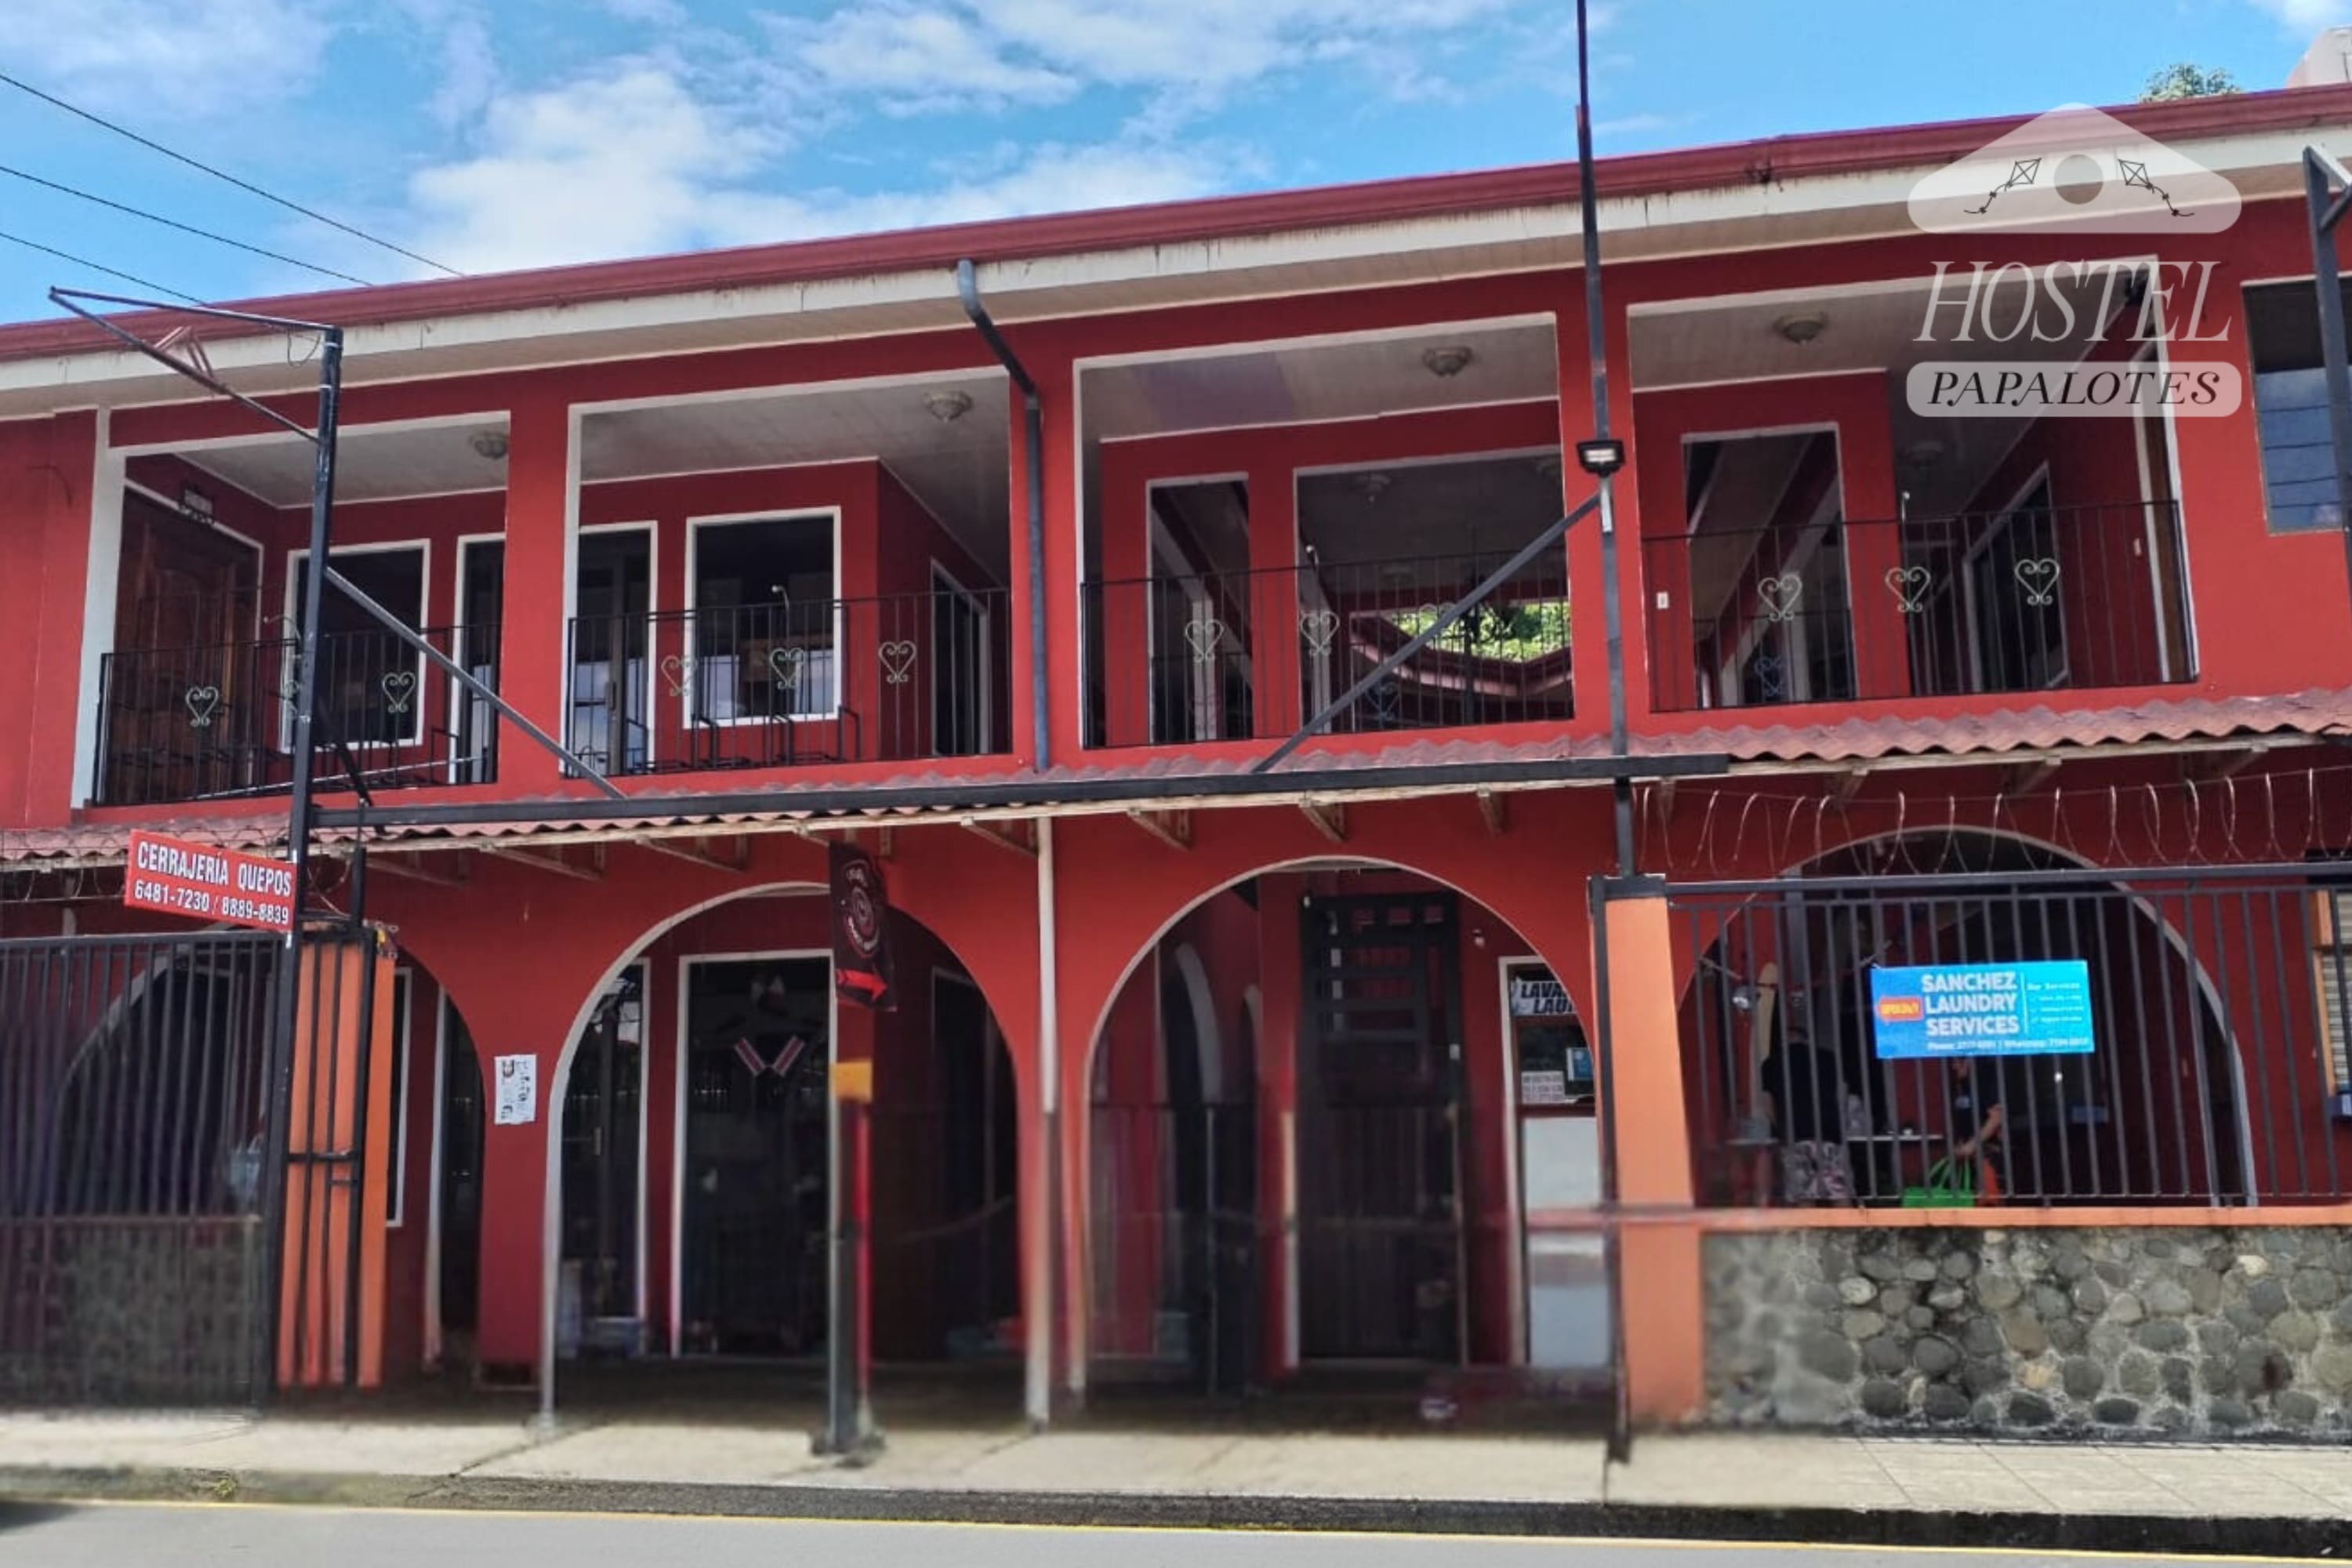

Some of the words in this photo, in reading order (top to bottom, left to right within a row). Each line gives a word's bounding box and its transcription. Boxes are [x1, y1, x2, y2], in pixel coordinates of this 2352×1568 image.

[137, 841, 229, 885] CERRAJERÍA
[238, 863, 292, 897] QUEPOS
[134, 880, 209, 913] 6481-7230
[1521, 982, 1567, 998] LAVA
[1922, 972, 2017, 993] SANCHEZ
[1534, 998, 1573, 1014] LAU
[1925, 993, 2017, 1014] LAUNDRY
[1926, 1015, 2020, 1036] SERVICES
